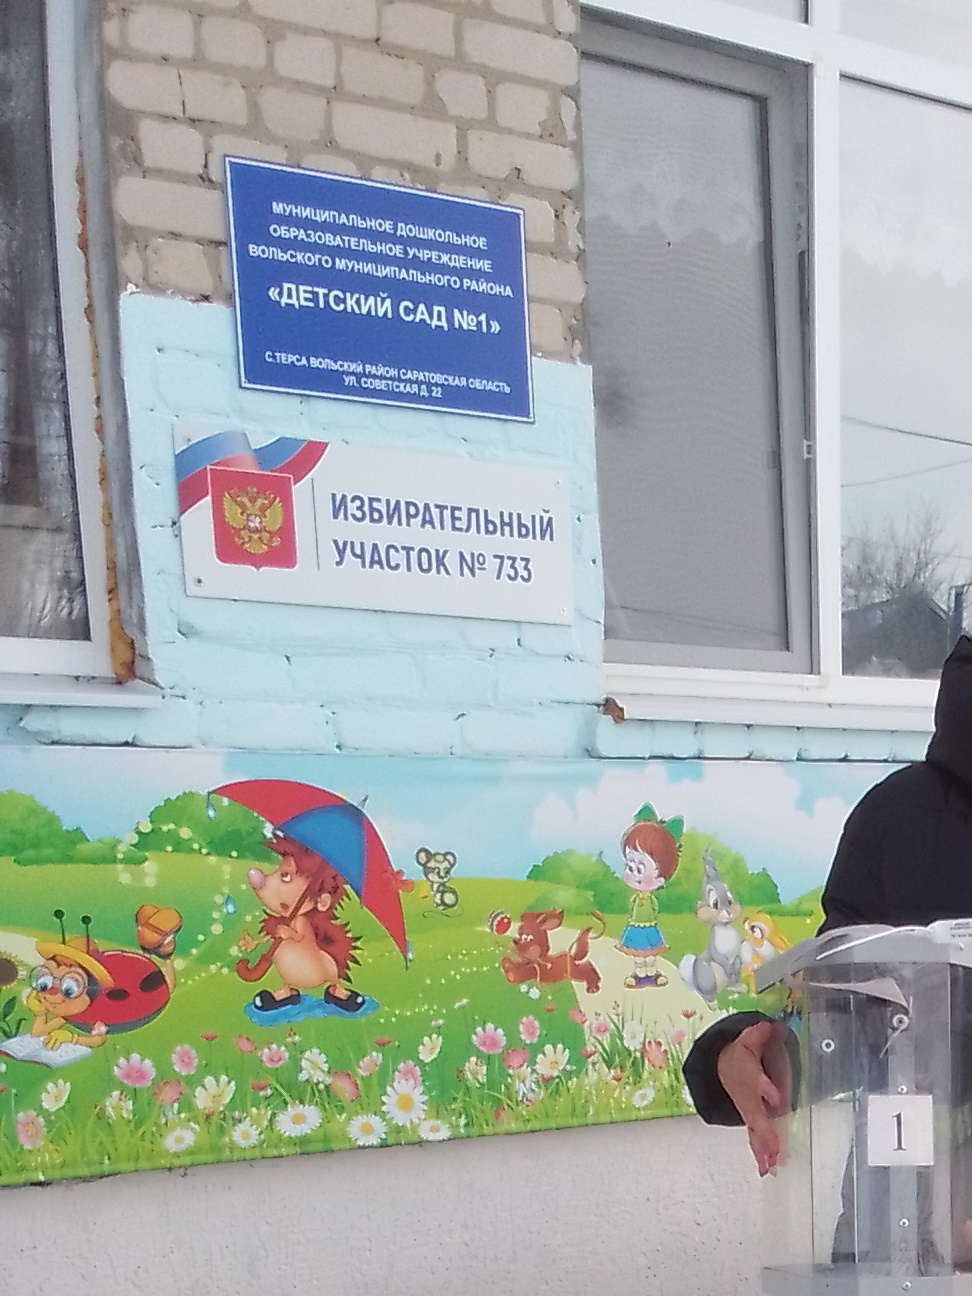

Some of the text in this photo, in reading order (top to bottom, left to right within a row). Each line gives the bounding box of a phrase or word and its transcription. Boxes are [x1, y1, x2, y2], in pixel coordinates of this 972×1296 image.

[269, 224, 493, 273] ОБРАЗОВАТЕЛЬНОЕ УЧРЕЖДЕНИЕ
[272, 201, 488, 250] МУНИЦИПАЛЬНОЕ ДОШКОЛЬНОЕ
[248, 243, 513, 298] ВОЛЬСКОГО МУНИЦИПАЛЬНОГО РАЙОНА
[268, 282, 500, 334] «ДЕТСКИЙ САД №1»
[264, 351, 511, 394] С.ТЕРСА ВОЛЬСКИЙ РАЙОН САРАТОВСКАЯ ОБЛАСТЬ
[343, 375, 360, 387] УЛ.
[361, 377, 418, 395] СОВЕТСКАЯ
[431, 386, 442, 398] 22
[331, 491, 555, 542] ИЗБИРАТЕЛЬНЫЙ
[333, 538, 533, 584] УЧАСТОК № 733
[892, 1112, 907, 1152] 1
